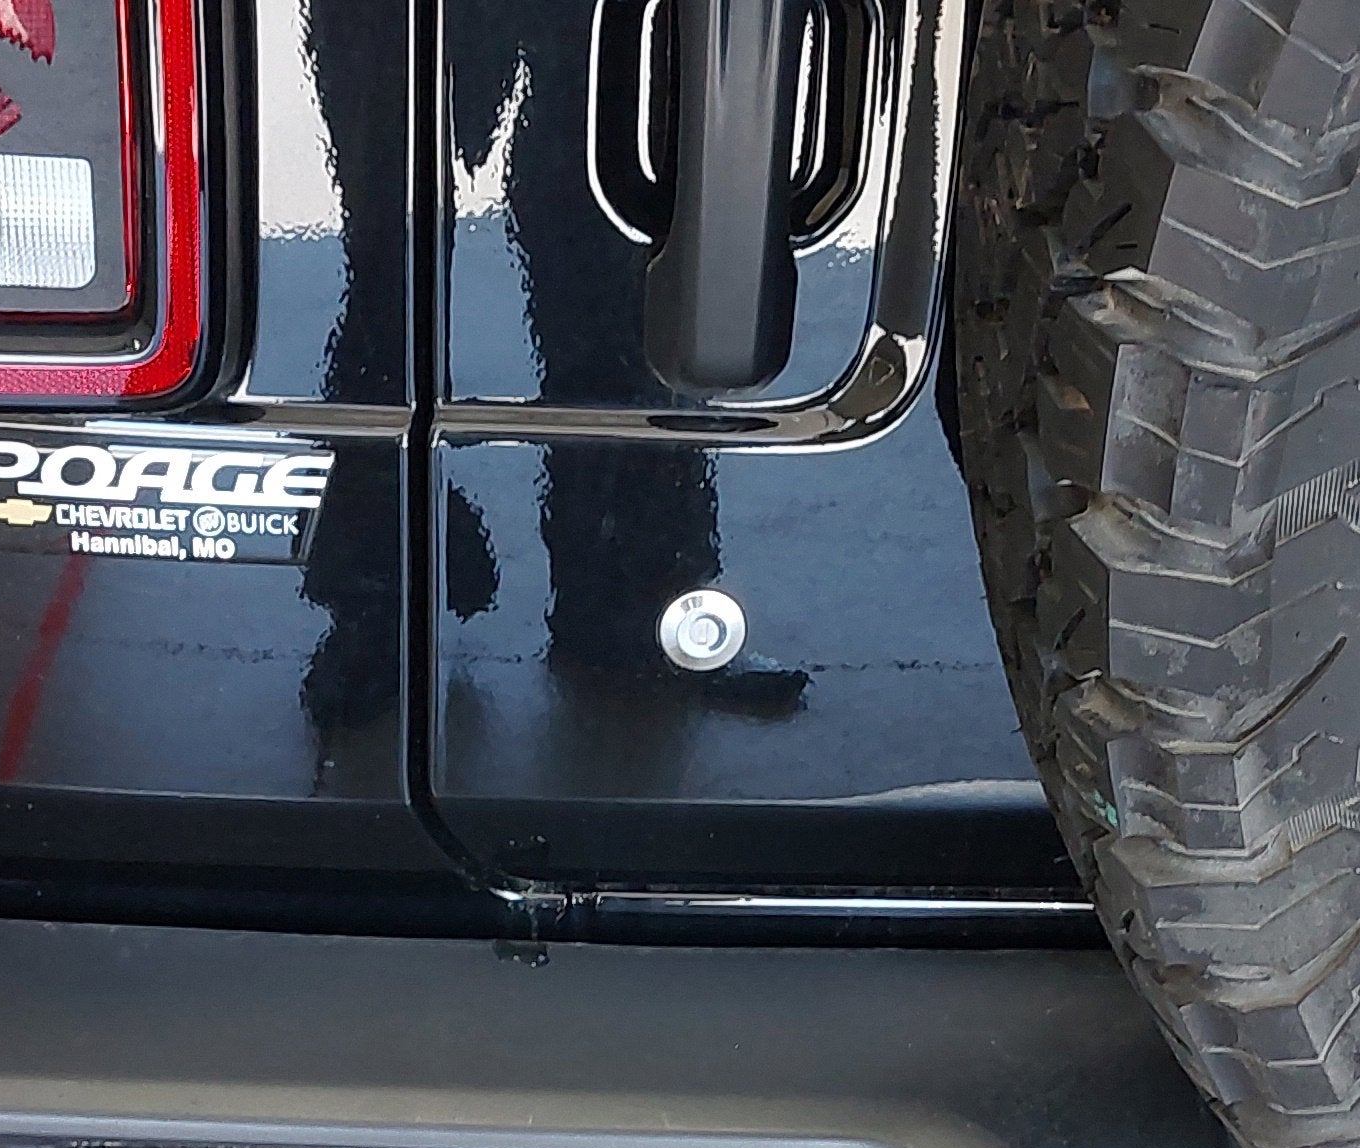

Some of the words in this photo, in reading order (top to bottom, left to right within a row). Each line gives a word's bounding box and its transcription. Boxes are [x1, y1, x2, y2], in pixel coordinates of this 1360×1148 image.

[56, 504, 190, 532] CHEVROLET
[227, 513, 299, 535] BUICK
[71, 531, 187, 560] Hannibal,
[192, 537, 237, 559] MO
